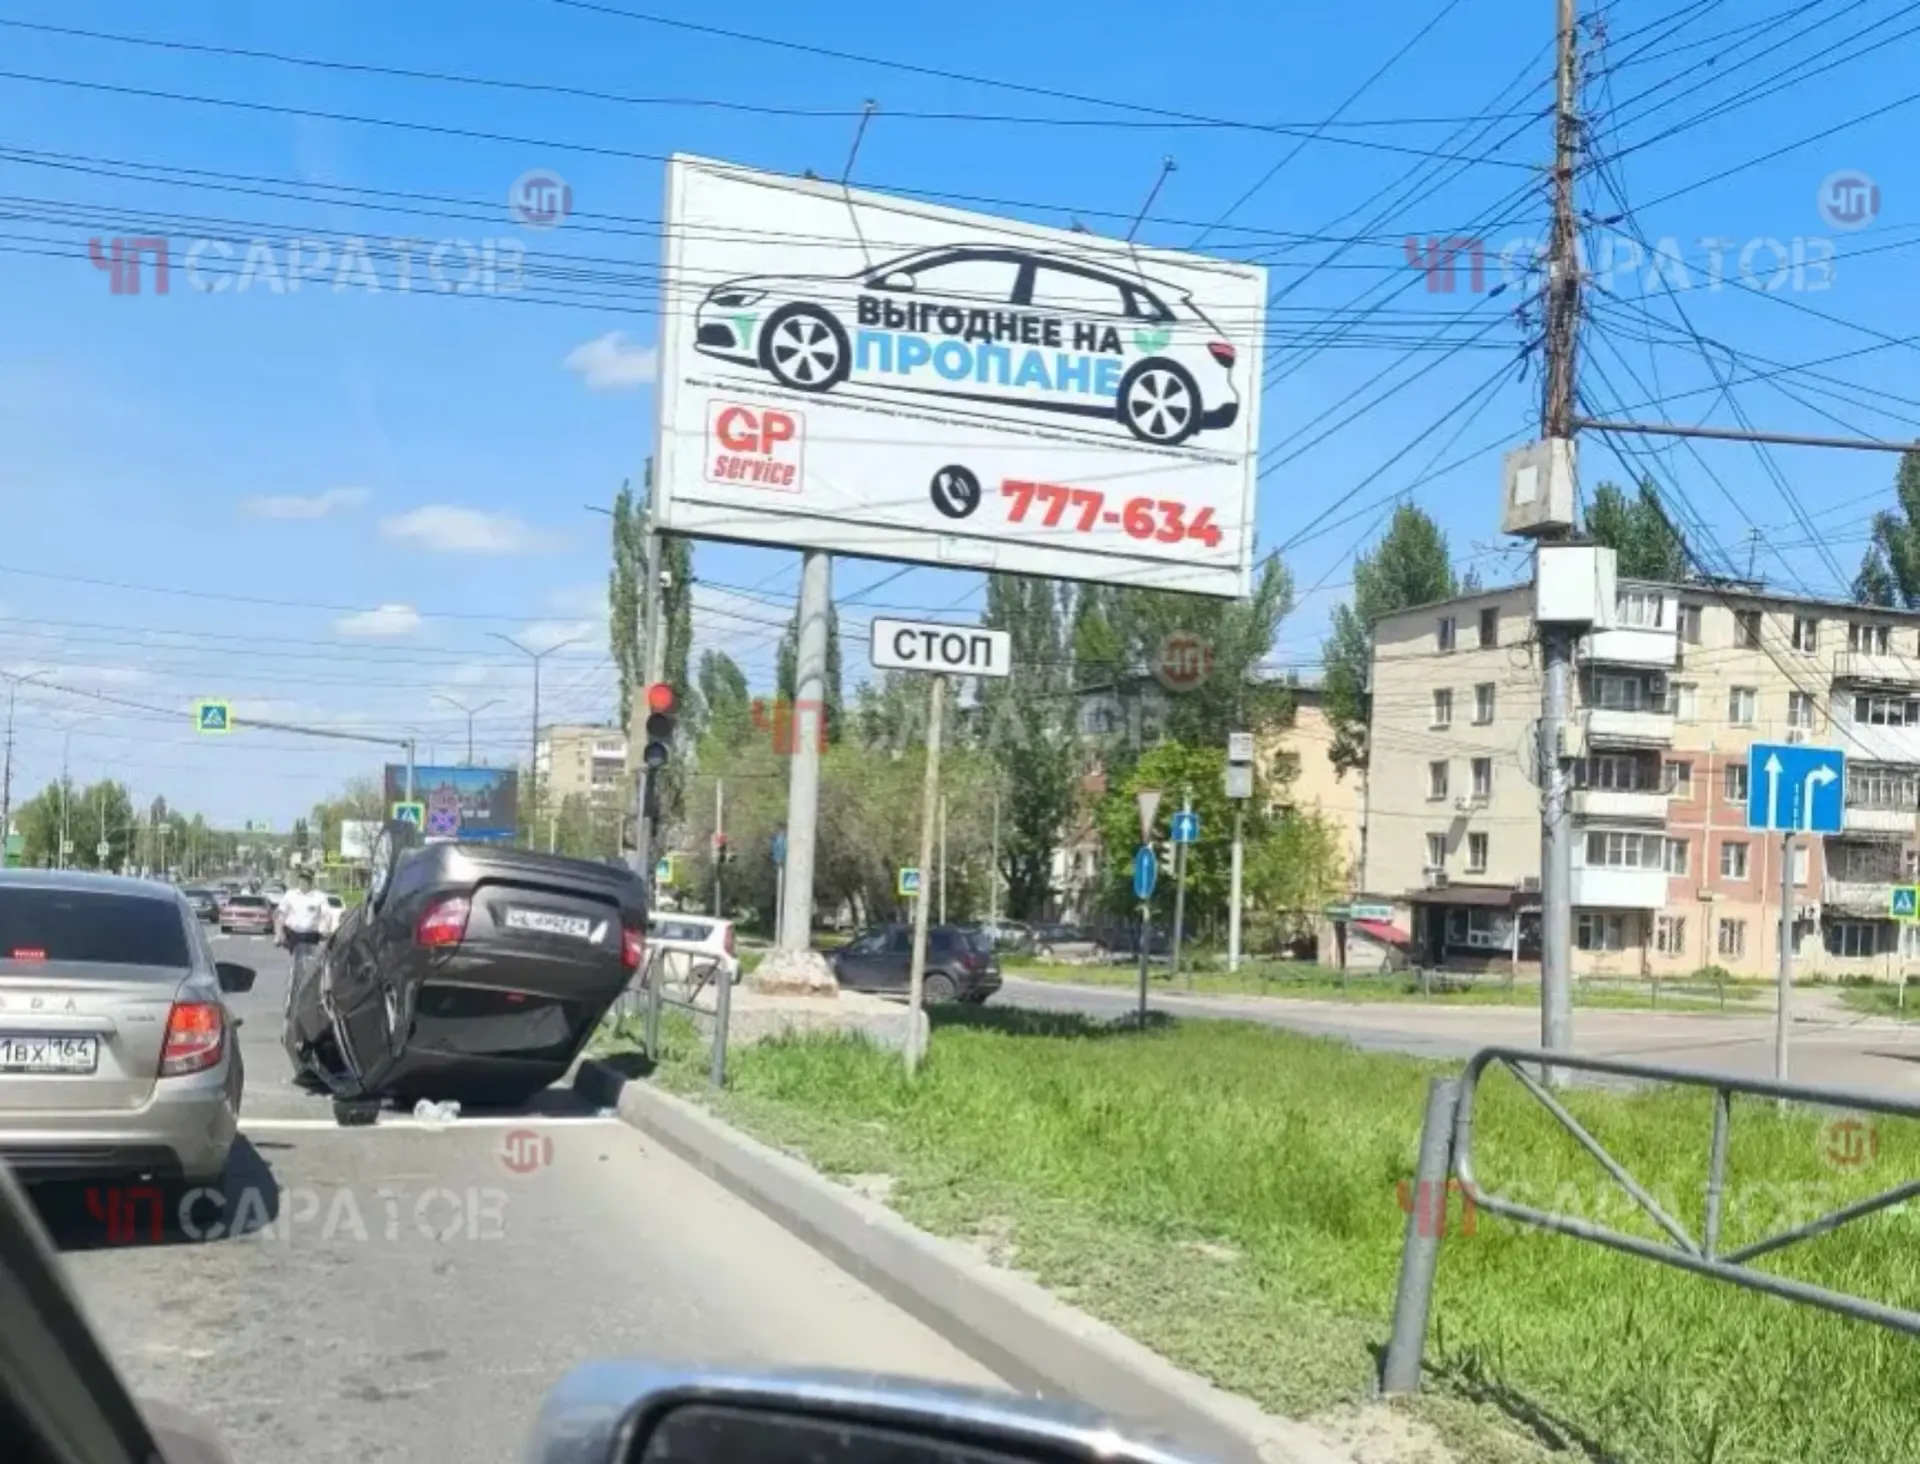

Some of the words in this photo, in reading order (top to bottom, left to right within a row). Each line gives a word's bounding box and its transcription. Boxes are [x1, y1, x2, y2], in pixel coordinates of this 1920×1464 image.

[857, 293, 1062, 349] ВЫГОДНЕЕ
[1071, 320, 1123, 355] НА
[853, 329, 1124, 398] ПРОПАНЕ
[716, 405, 796, 456] GP
[713, 456, 797, 487] service
[1001, 479, 1224, 549] 777-634
[893, 627, 994, 669] СТОП
[53, 1038, 89, 1058] 164
